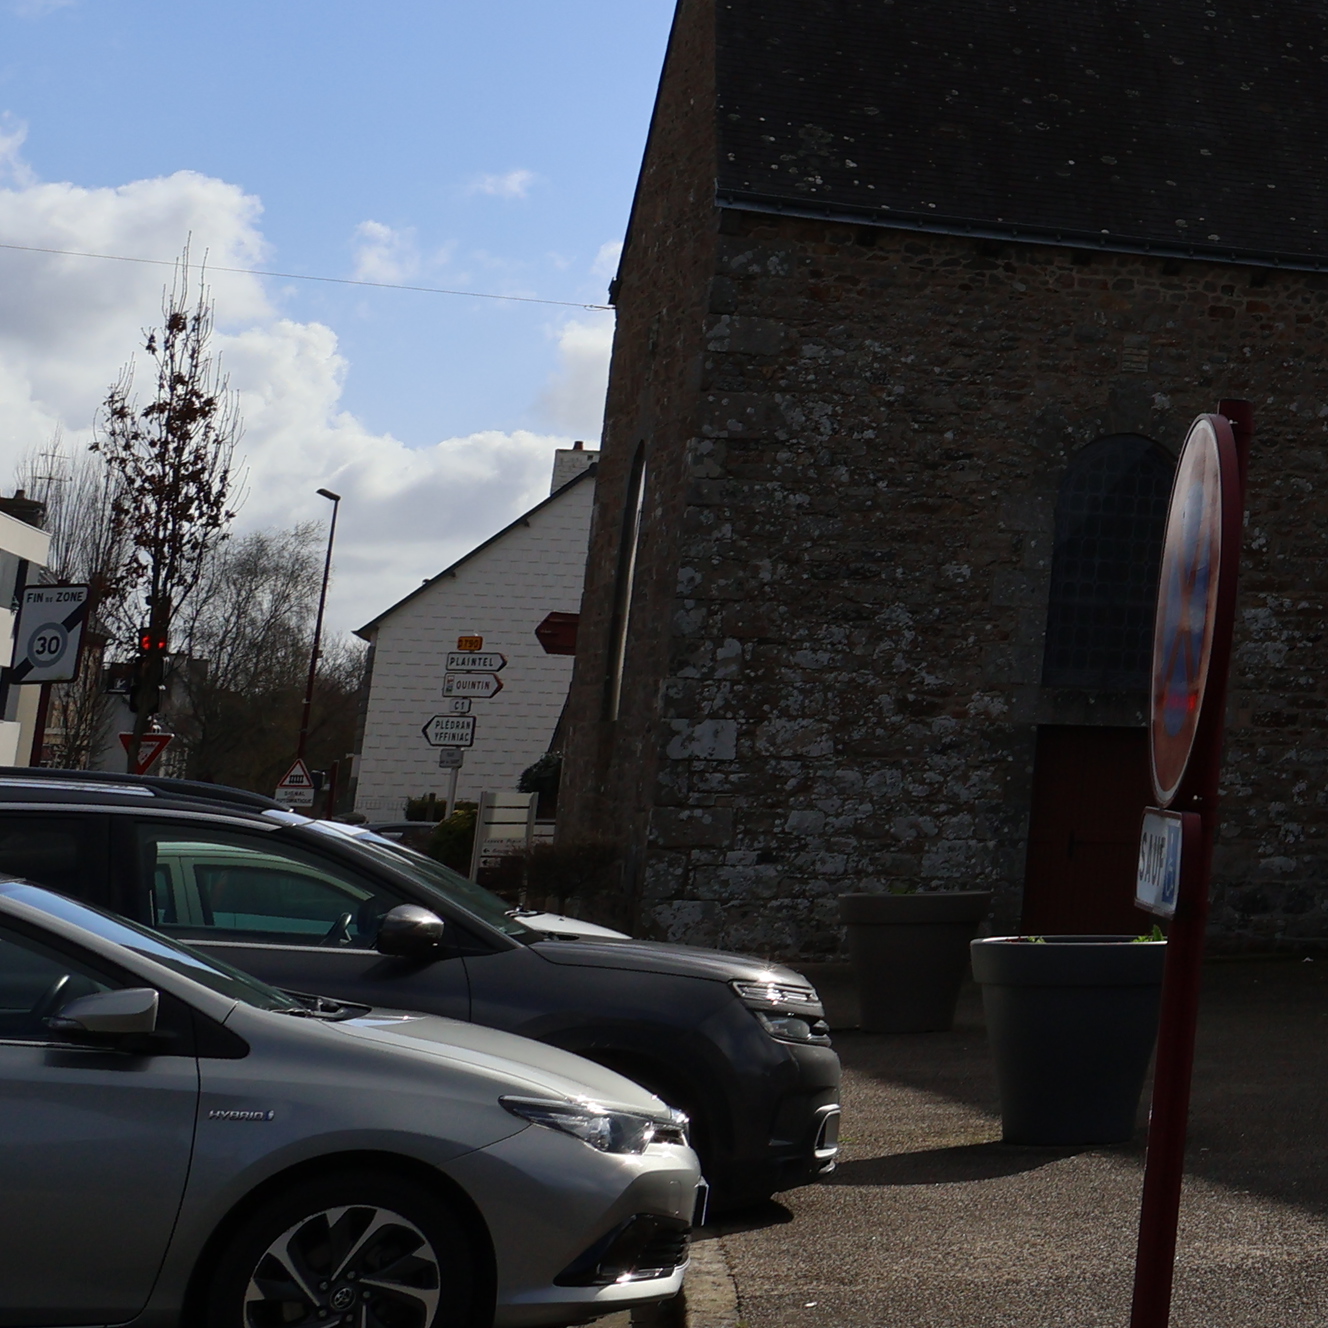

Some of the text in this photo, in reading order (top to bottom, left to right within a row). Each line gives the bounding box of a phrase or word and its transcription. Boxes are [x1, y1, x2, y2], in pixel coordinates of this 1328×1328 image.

[26, 593, 44, 603] FIN
[56, 591, 84, 602] ZONE
[35, 636, 60, 655] 30
[449, 657, 493, 667] PLAINTEL
[456, 680, 491, 690] QUINTIN
[435, 719, 471, 730] PLÉDRAN
[434, 732, 469, 742] YFFINIAC
[1139, 832, 1166, 886] SAUF
[208, 1109, 264, 1121] HYBRID
